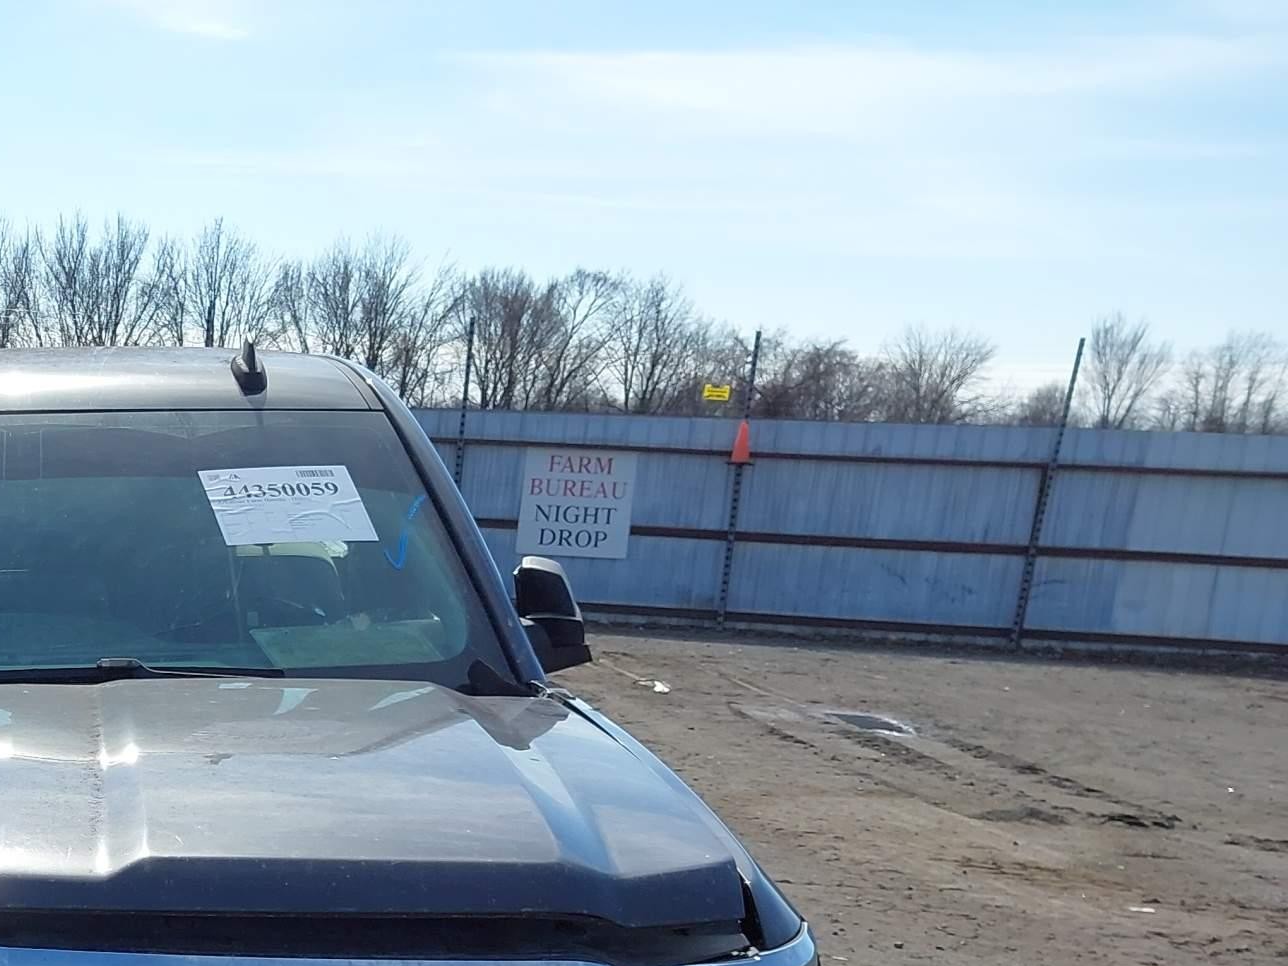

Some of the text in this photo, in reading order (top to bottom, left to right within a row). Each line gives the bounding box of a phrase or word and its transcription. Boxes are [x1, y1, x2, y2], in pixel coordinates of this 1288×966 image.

[548, 455, 614, 475] FARM
[223, 482, 339, 498] 44350059
[529, 478, 628, 499] BUREAU
[535, 504, 617, 525] NIGHT
[538, 527, 608, 548] DROP
